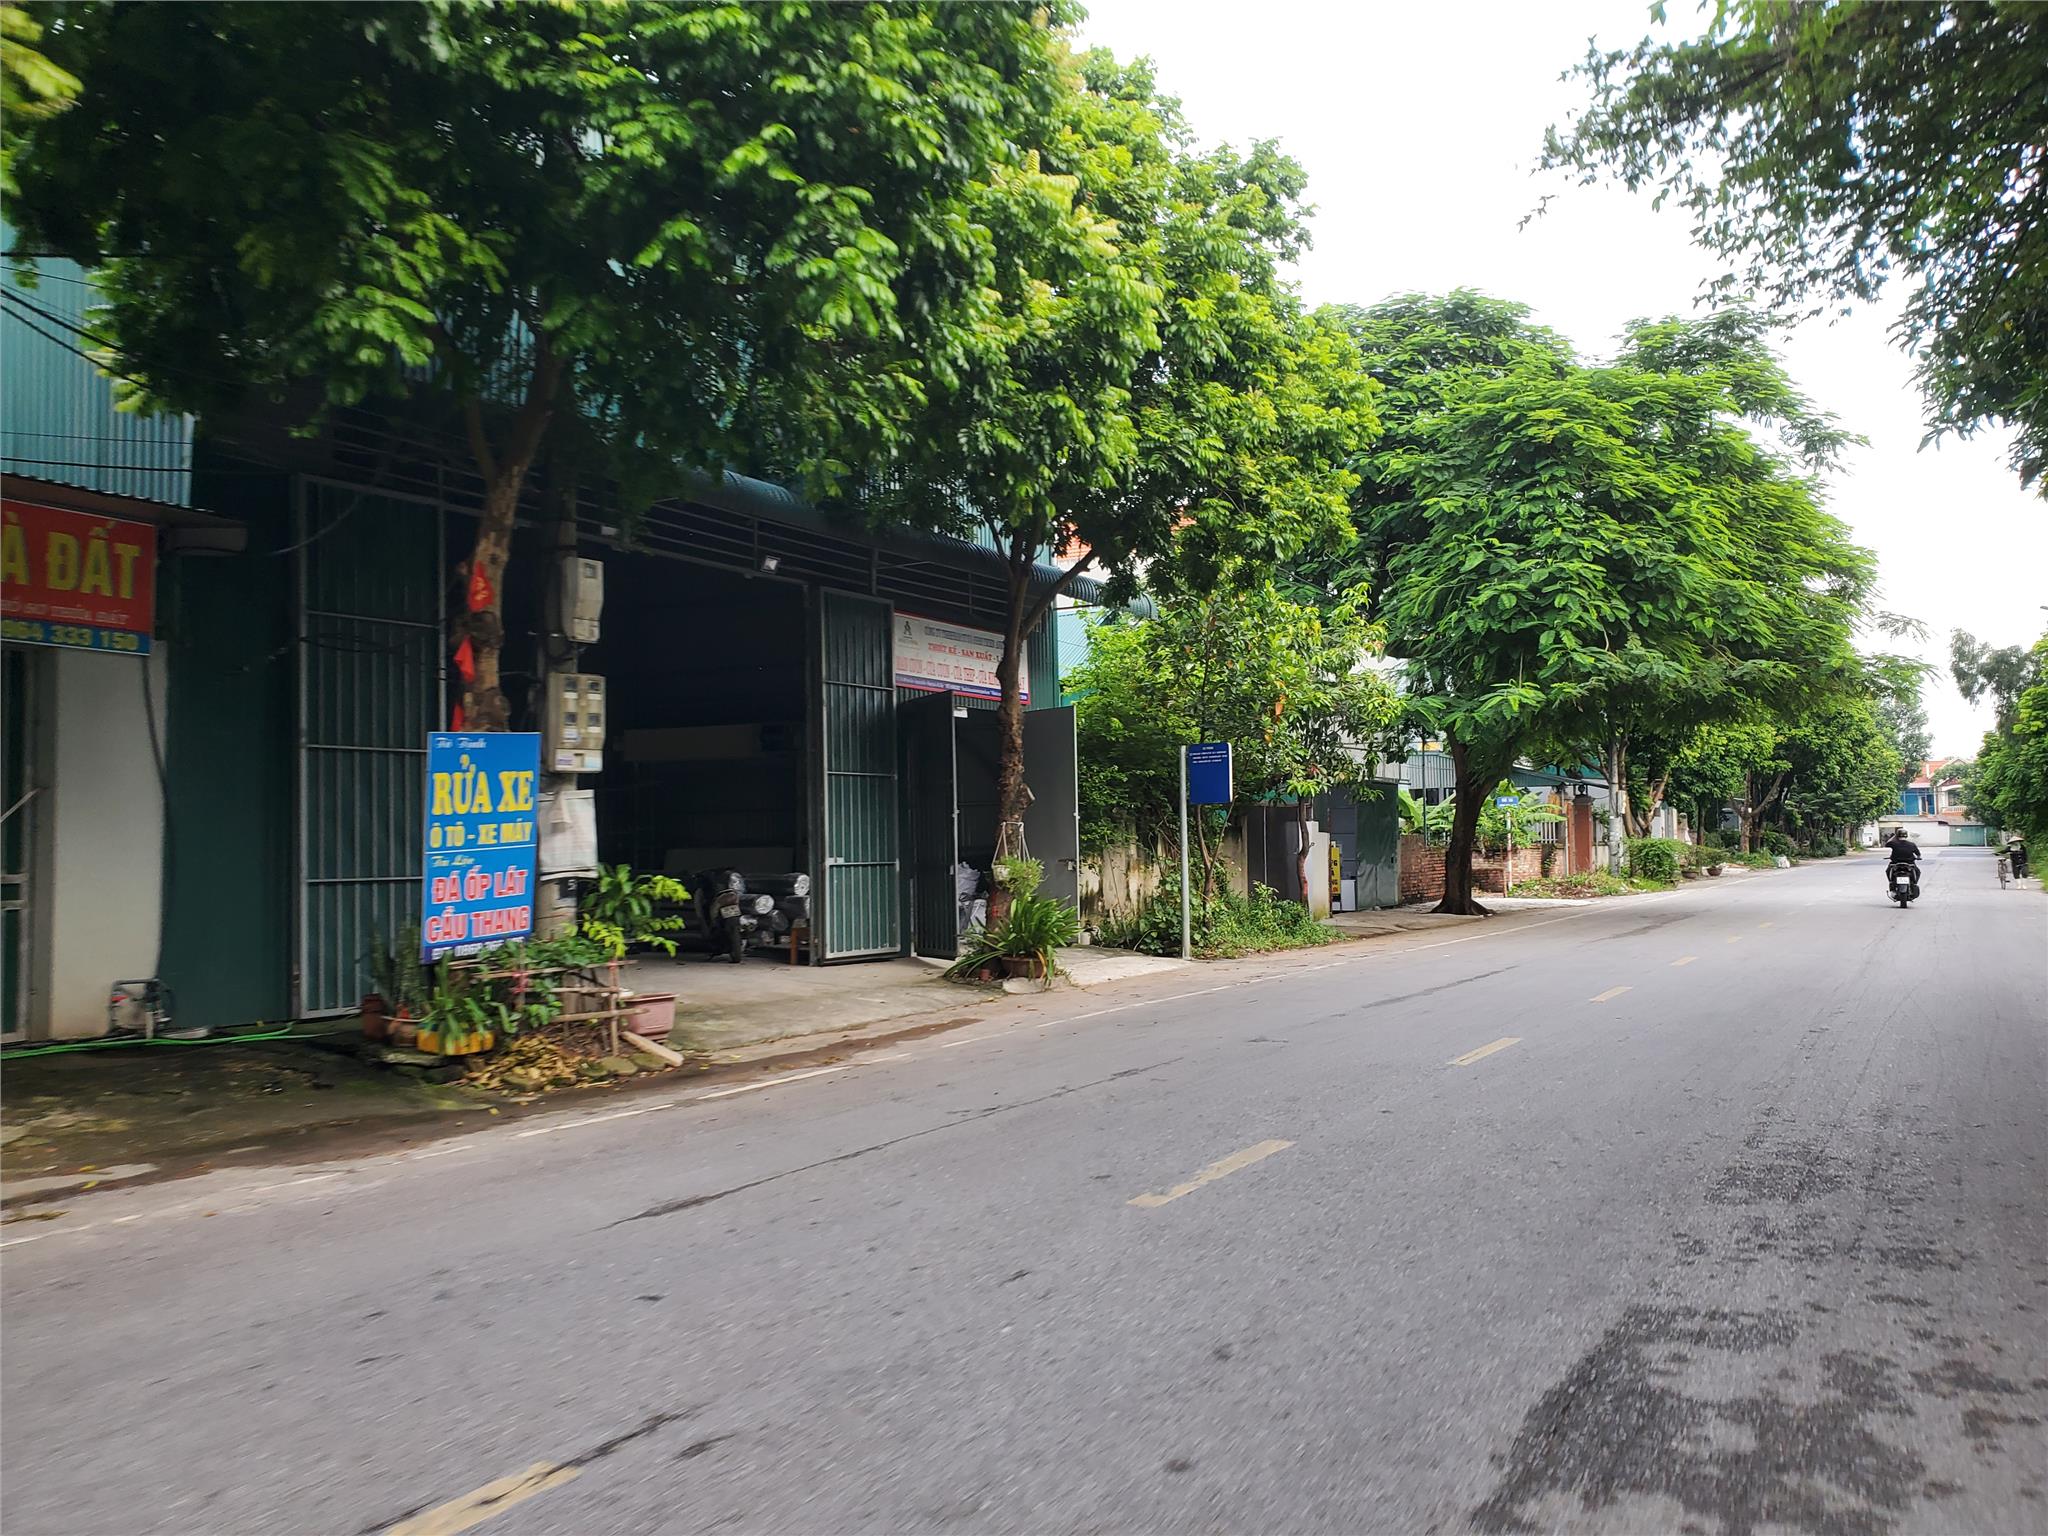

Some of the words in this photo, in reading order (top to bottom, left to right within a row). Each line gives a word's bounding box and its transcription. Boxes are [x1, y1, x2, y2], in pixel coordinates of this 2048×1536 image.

[46, 521, 142, 599] ĐẤT
[50, 624, 92, 646] 333
[975, 649, 992, 661] XUẤT
[431, 754, 492, 816] RỬA
[497, 770, 534, 813] XE
[430, 822, 442, 848] Ô
[445, 821, 465, 847] TÔ
[477, 823, 498, 845] XE
[500, 817, 533, 843] MÁY
[431, 869, 461, 904] ĐÁ
[464, 864, 492, 901] ỐP
[493, 864, 528, 898] LÁT
[425, 906, 468, 943] CẦU
[470, 905, 531, 937] THANG
